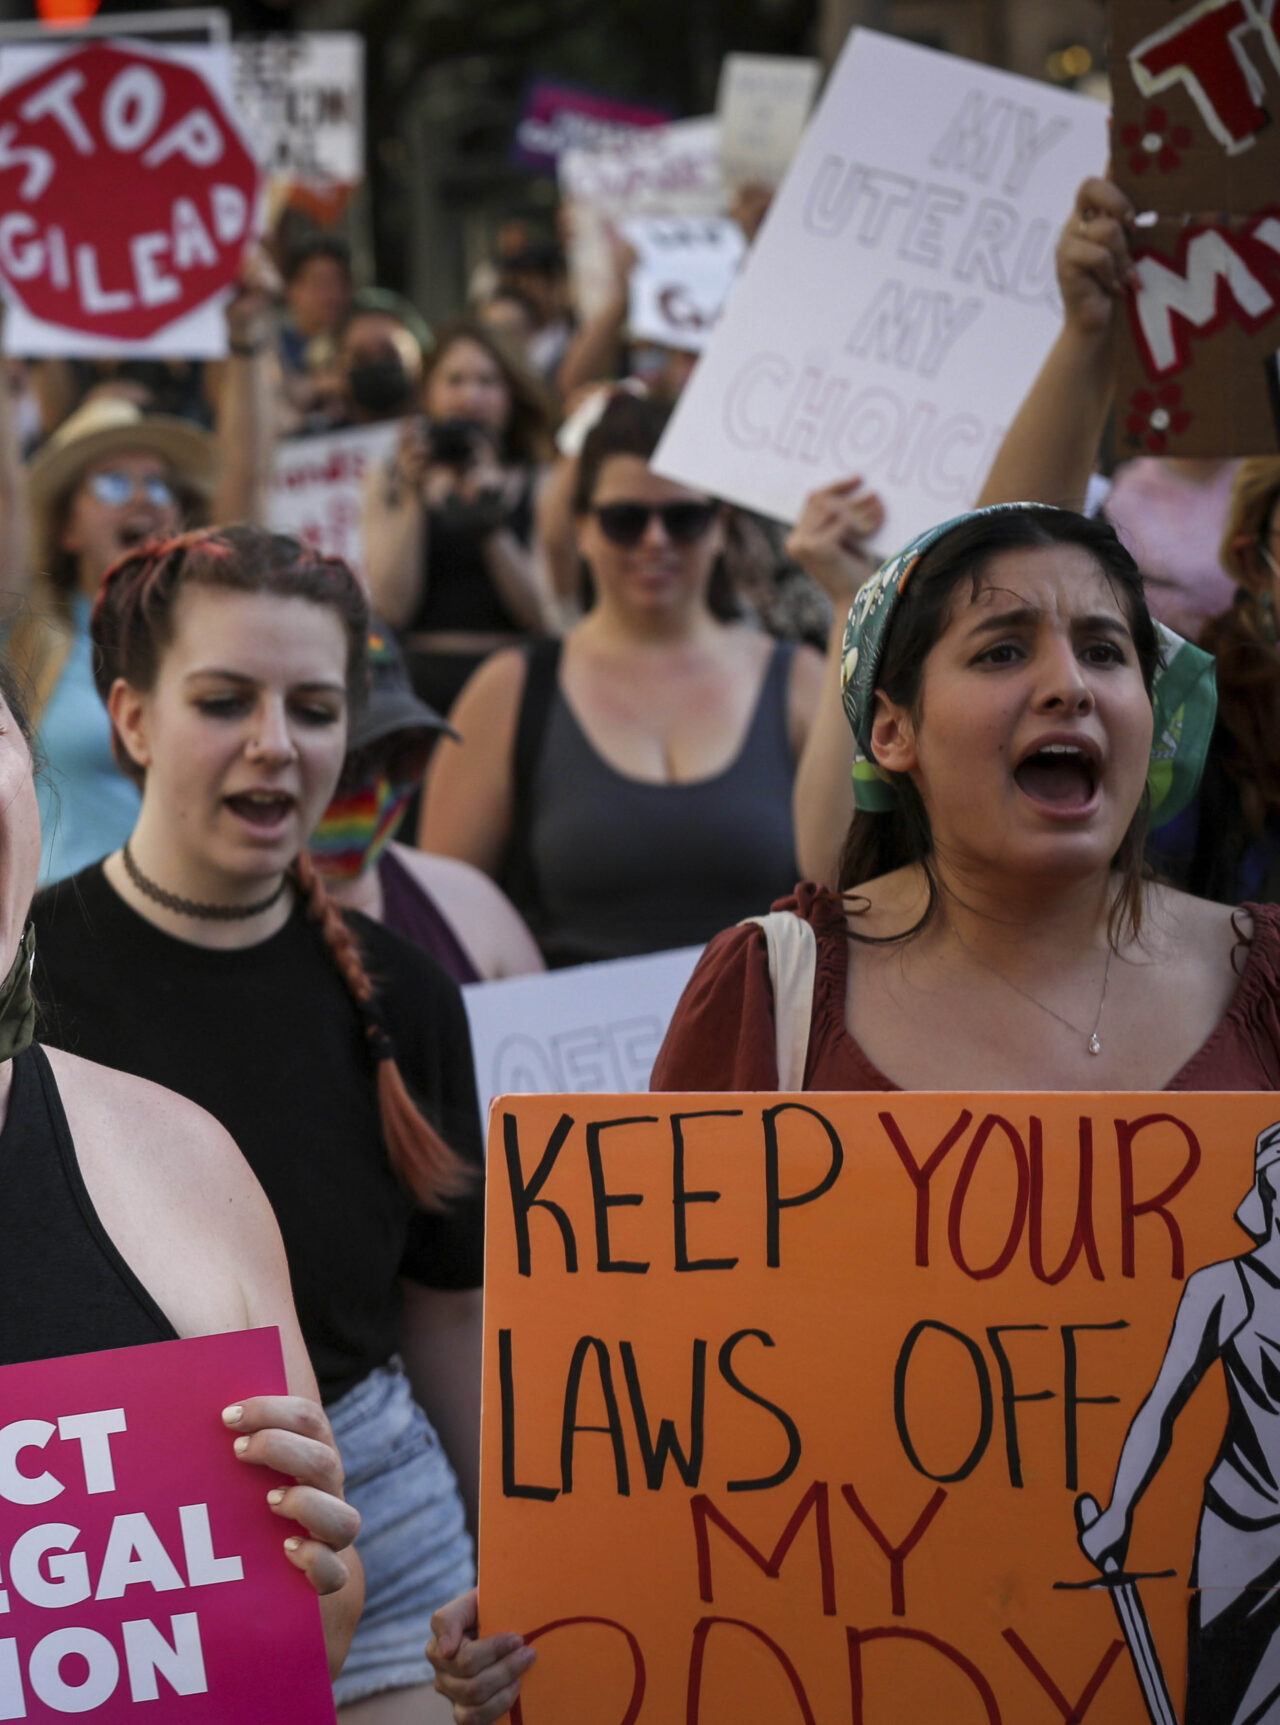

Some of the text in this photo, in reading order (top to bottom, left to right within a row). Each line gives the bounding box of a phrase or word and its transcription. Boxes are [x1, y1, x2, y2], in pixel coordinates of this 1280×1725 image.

[930, 90, 1073, 197] MY
[1128, 0, 1280, 156] T
[803, 152, 1064, 319] UTERU
[845, 278, 984, 381] MY
[722, 349, 1010, 503] CHOIC
[502, 1102, 1203, 1286] KEEP YOUR
[498, 1319, 1131, 1503] LAWS OFF
[689, 1480, 949, 1617] MY
